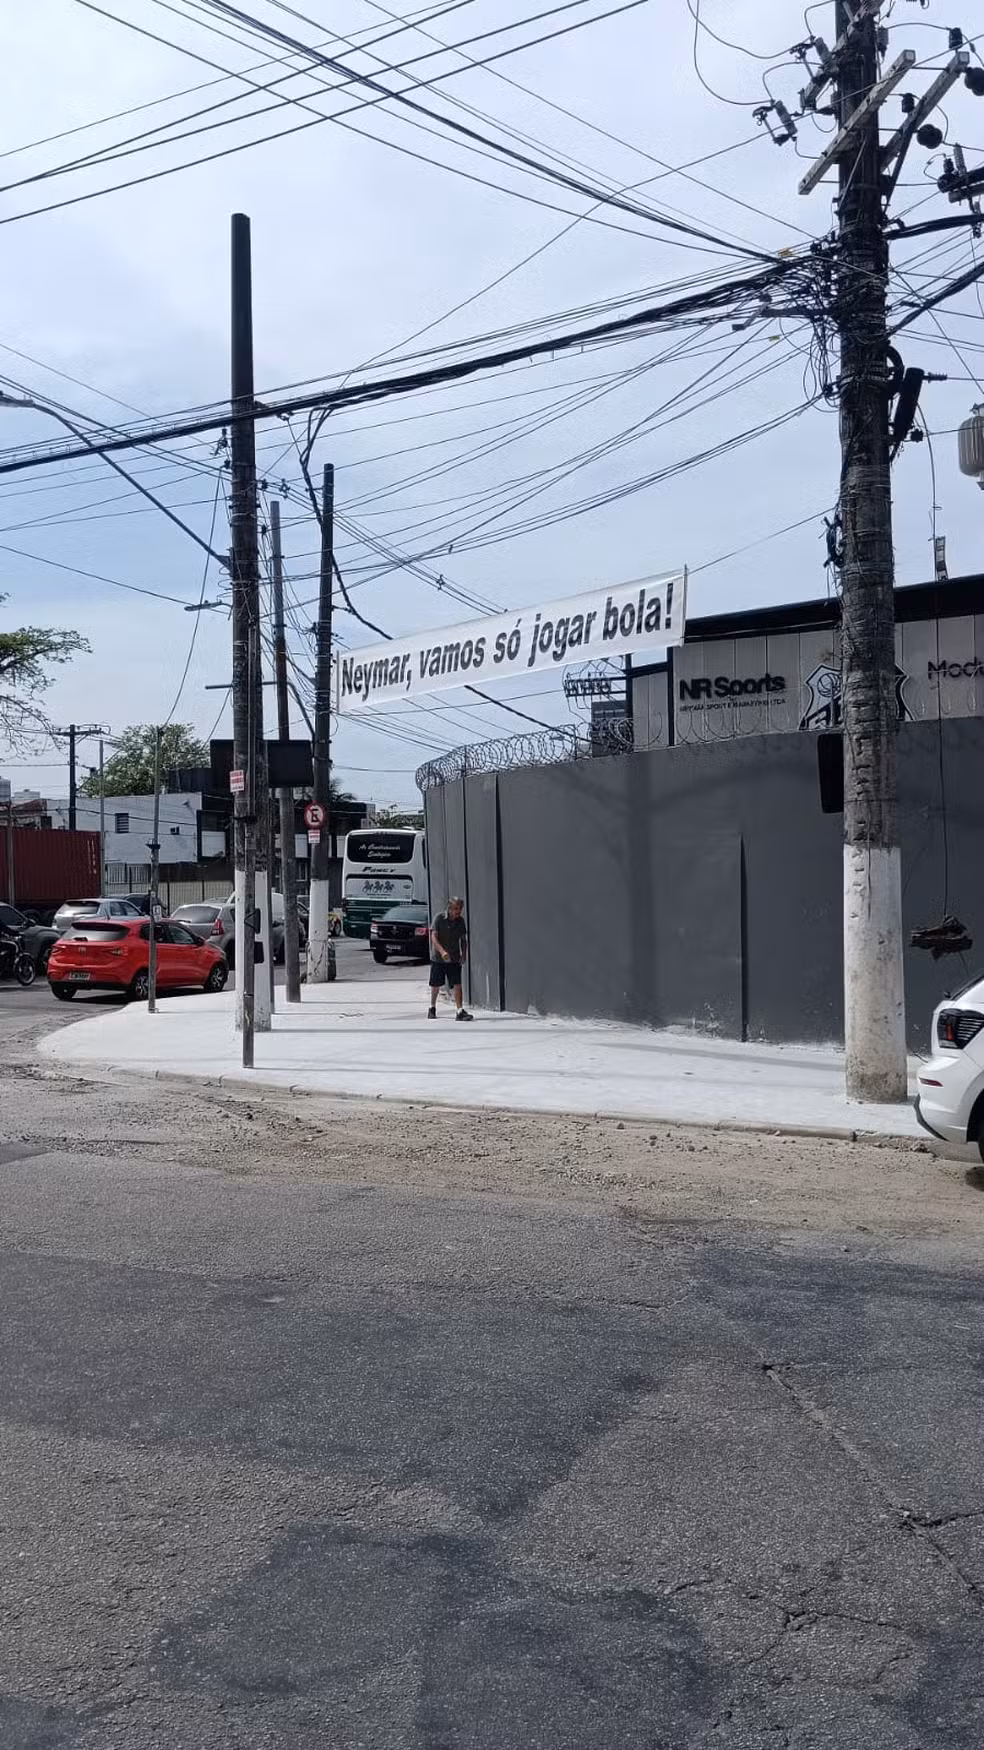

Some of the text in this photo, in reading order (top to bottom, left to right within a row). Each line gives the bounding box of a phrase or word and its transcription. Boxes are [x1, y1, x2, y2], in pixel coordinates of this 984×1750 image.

[341, 583, 674, 702] Neymar, vamos só jogar bola!
